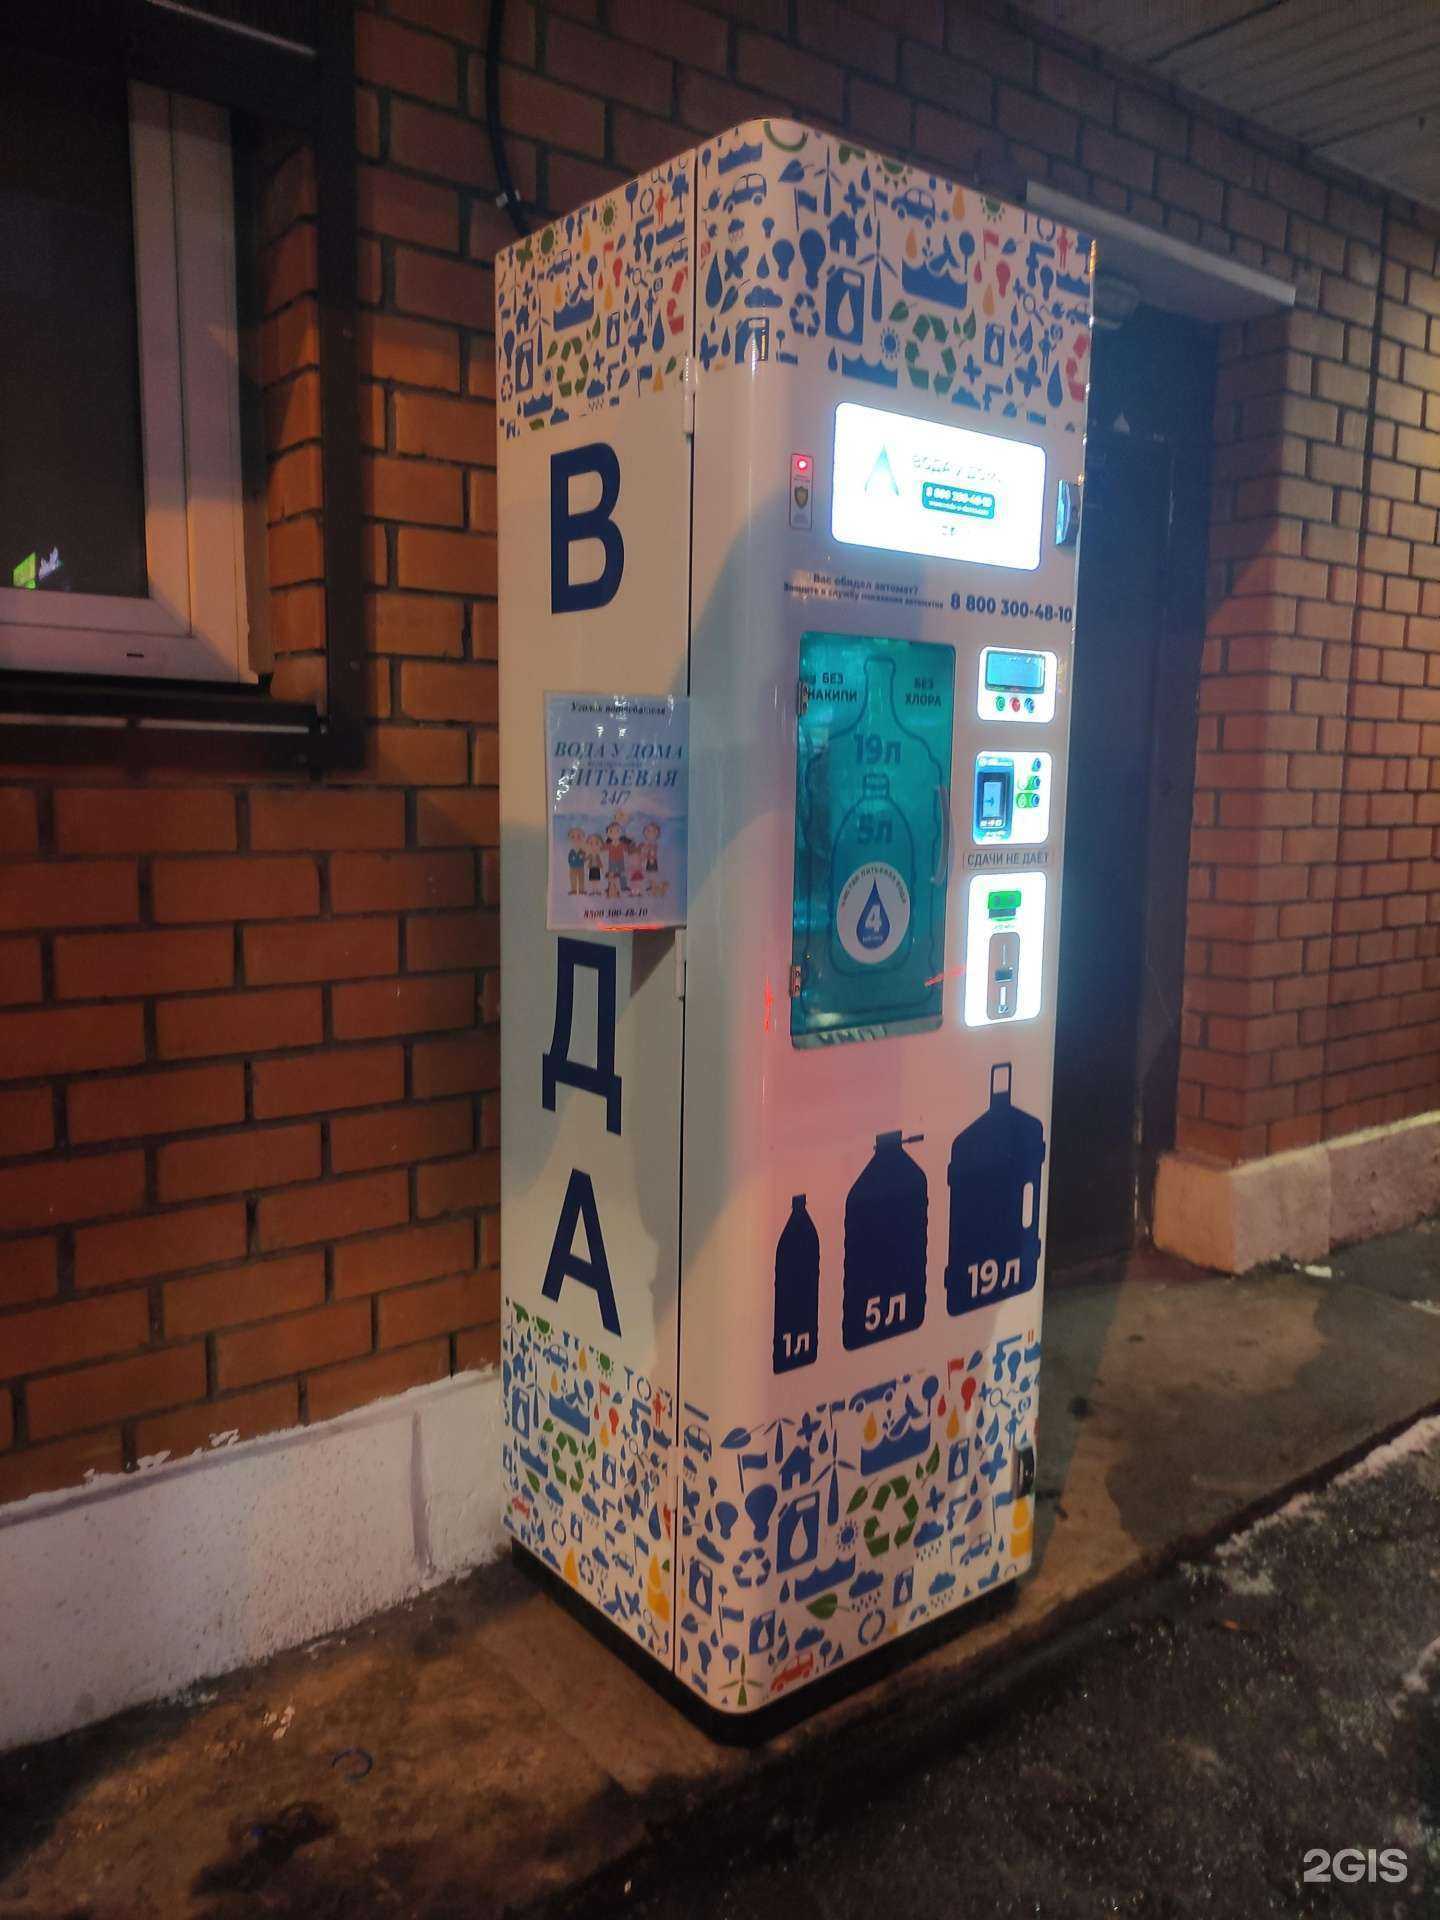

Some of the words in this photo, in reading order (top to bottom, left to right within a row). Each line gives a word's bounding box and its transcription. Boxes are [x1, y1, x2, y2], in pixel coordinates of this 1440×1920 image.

[950, 592, 960, 610] 8
[965, 594, 996, 614] 800
[1001, 598, 1072, 623] 300-48-10
[822, 672, 844, 685] БЕЗ
[914, 677, 934, 690] БЕЗ
[807, 687, 857, 701] НАКИПИ
[905, 692, 942, 708] ХЛОРА
[555, 741, 605, 760] ВОДА
[967, 853, 1003, 867] СДАЧИ
[1006, 853, 1020, 865] НЕ
